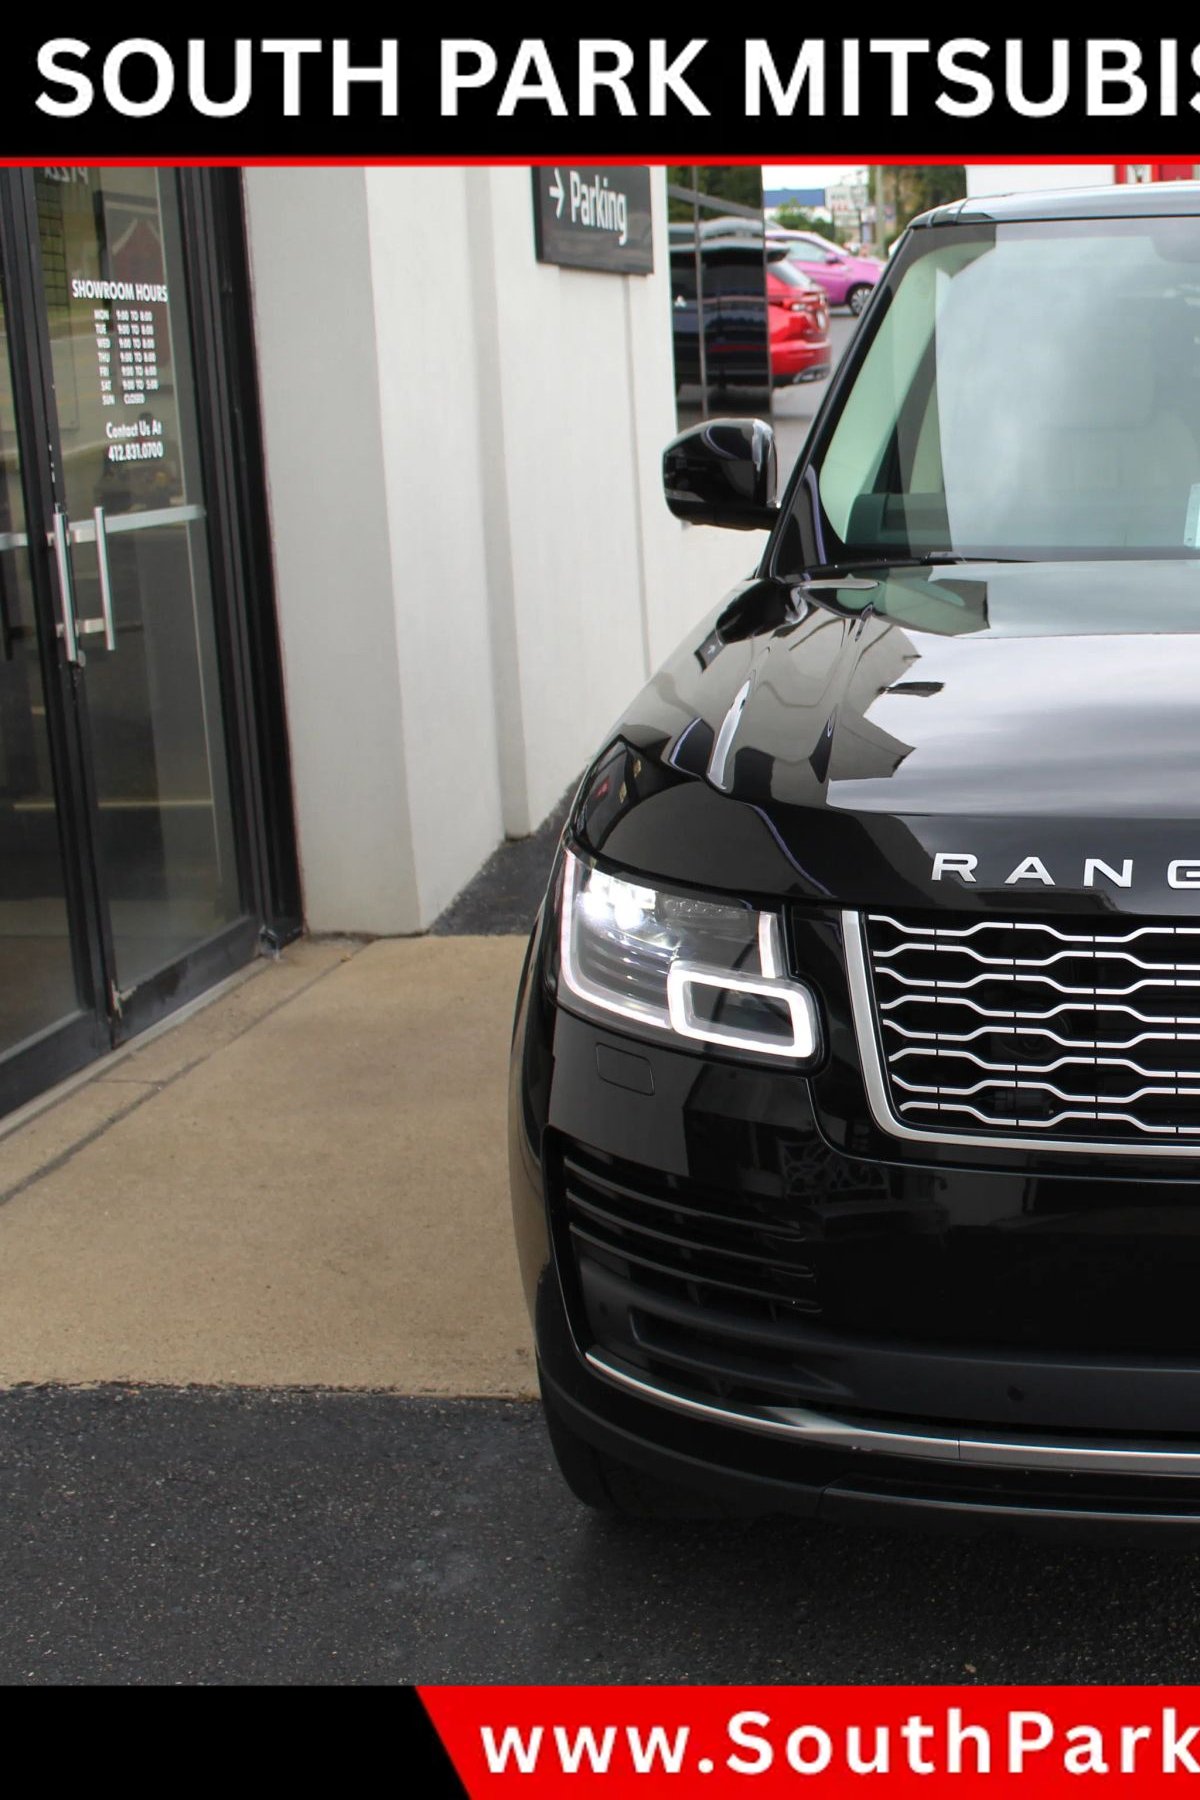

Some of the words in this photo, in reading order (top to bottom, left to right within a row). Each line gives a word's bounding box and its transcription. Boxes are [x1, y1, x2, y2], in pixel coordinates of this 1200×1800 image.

[569, 170, 628, 246] Parking
[71, 279, 135, 301] SHOWROOM
[135, 283, 169, 302] HOURS
[106, 421, 138, 439] Contact
[138, 420, 150, 436] Us
[151, 419, 162, 435] At
[108, 441, 164, 462] 412.831.0700
